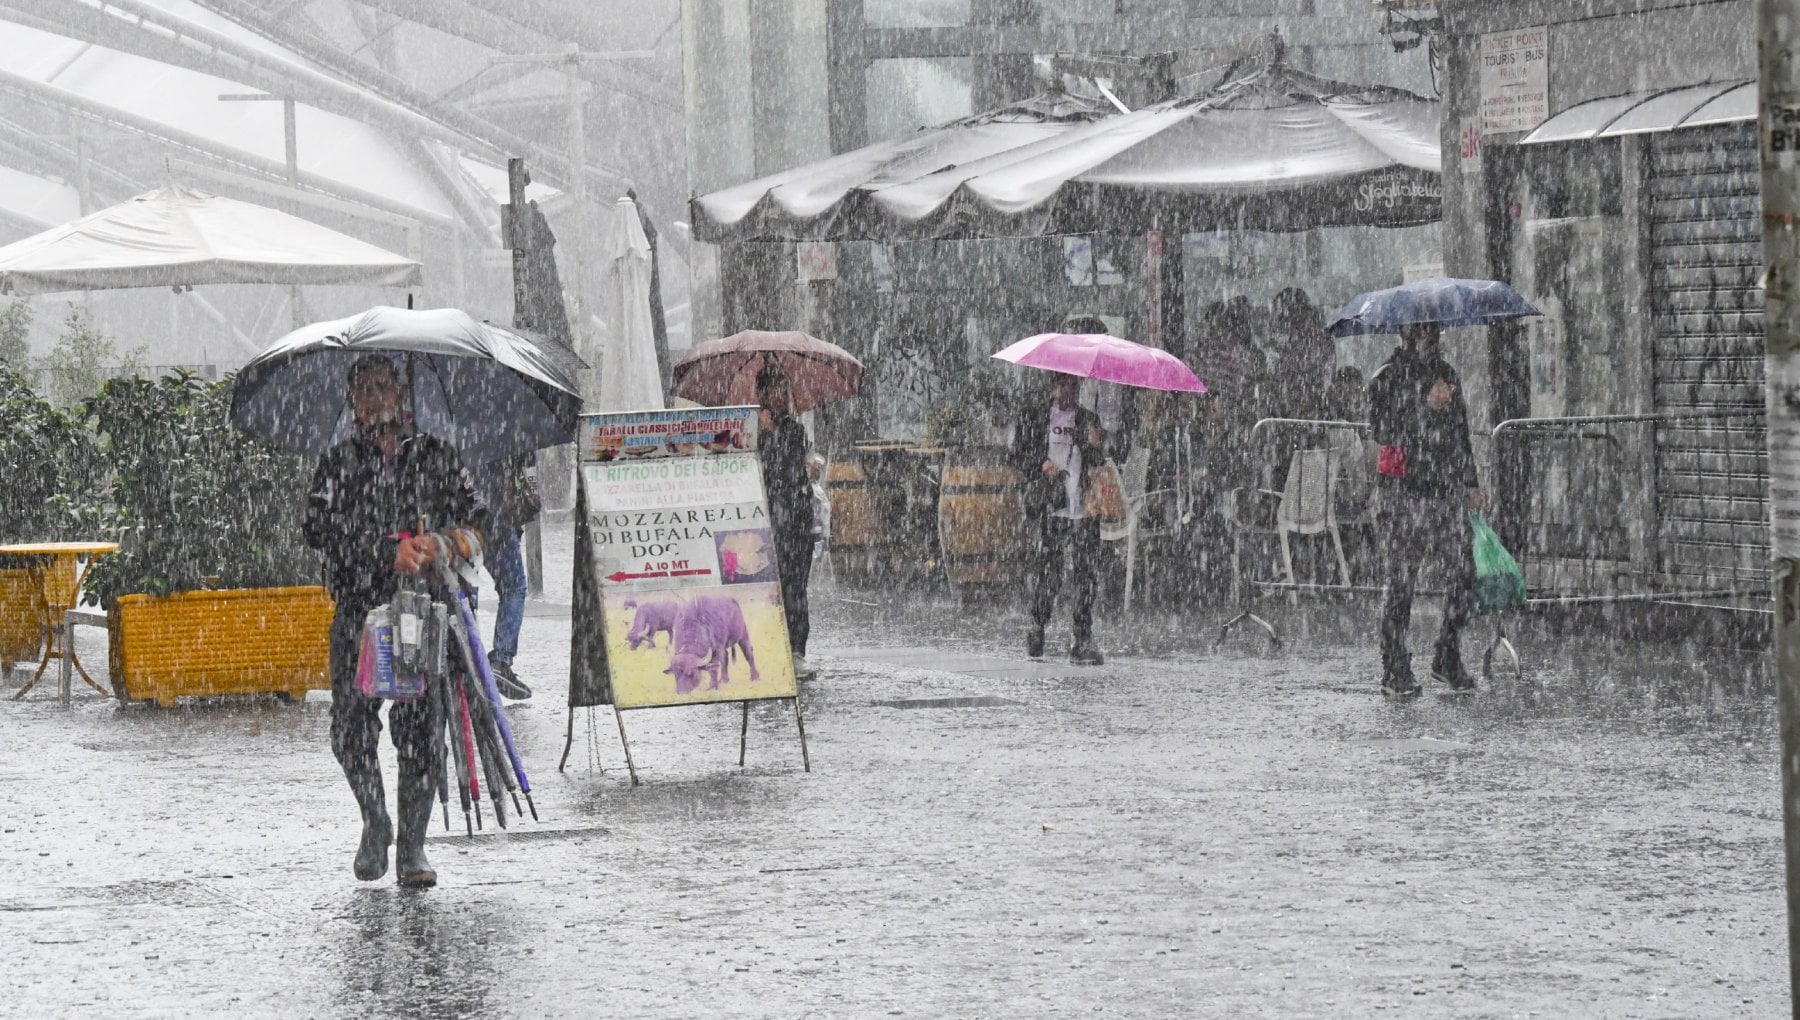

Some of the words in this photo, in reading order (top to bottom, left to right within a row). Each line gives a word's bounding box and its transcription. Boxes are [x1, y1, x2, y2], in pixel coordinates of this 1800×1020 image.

[1526, 50, 1544, 61] BUS
[599, 424, 634, 437] TARALLI
[638, 422, 681, 434] CLASSICI
[607, 464, 668, 482] RITROVO
[674, 462, 696, 478] DEI
[592, 505, 764, 528] MOZZARELLA
[593, 531, 613, 544] DI
[620, 526, 712, 544] BUFALA
[631, 543, 679, 558] DOC
[644, 561, 653, 571] A
[672, 559, 690, 569] MT
